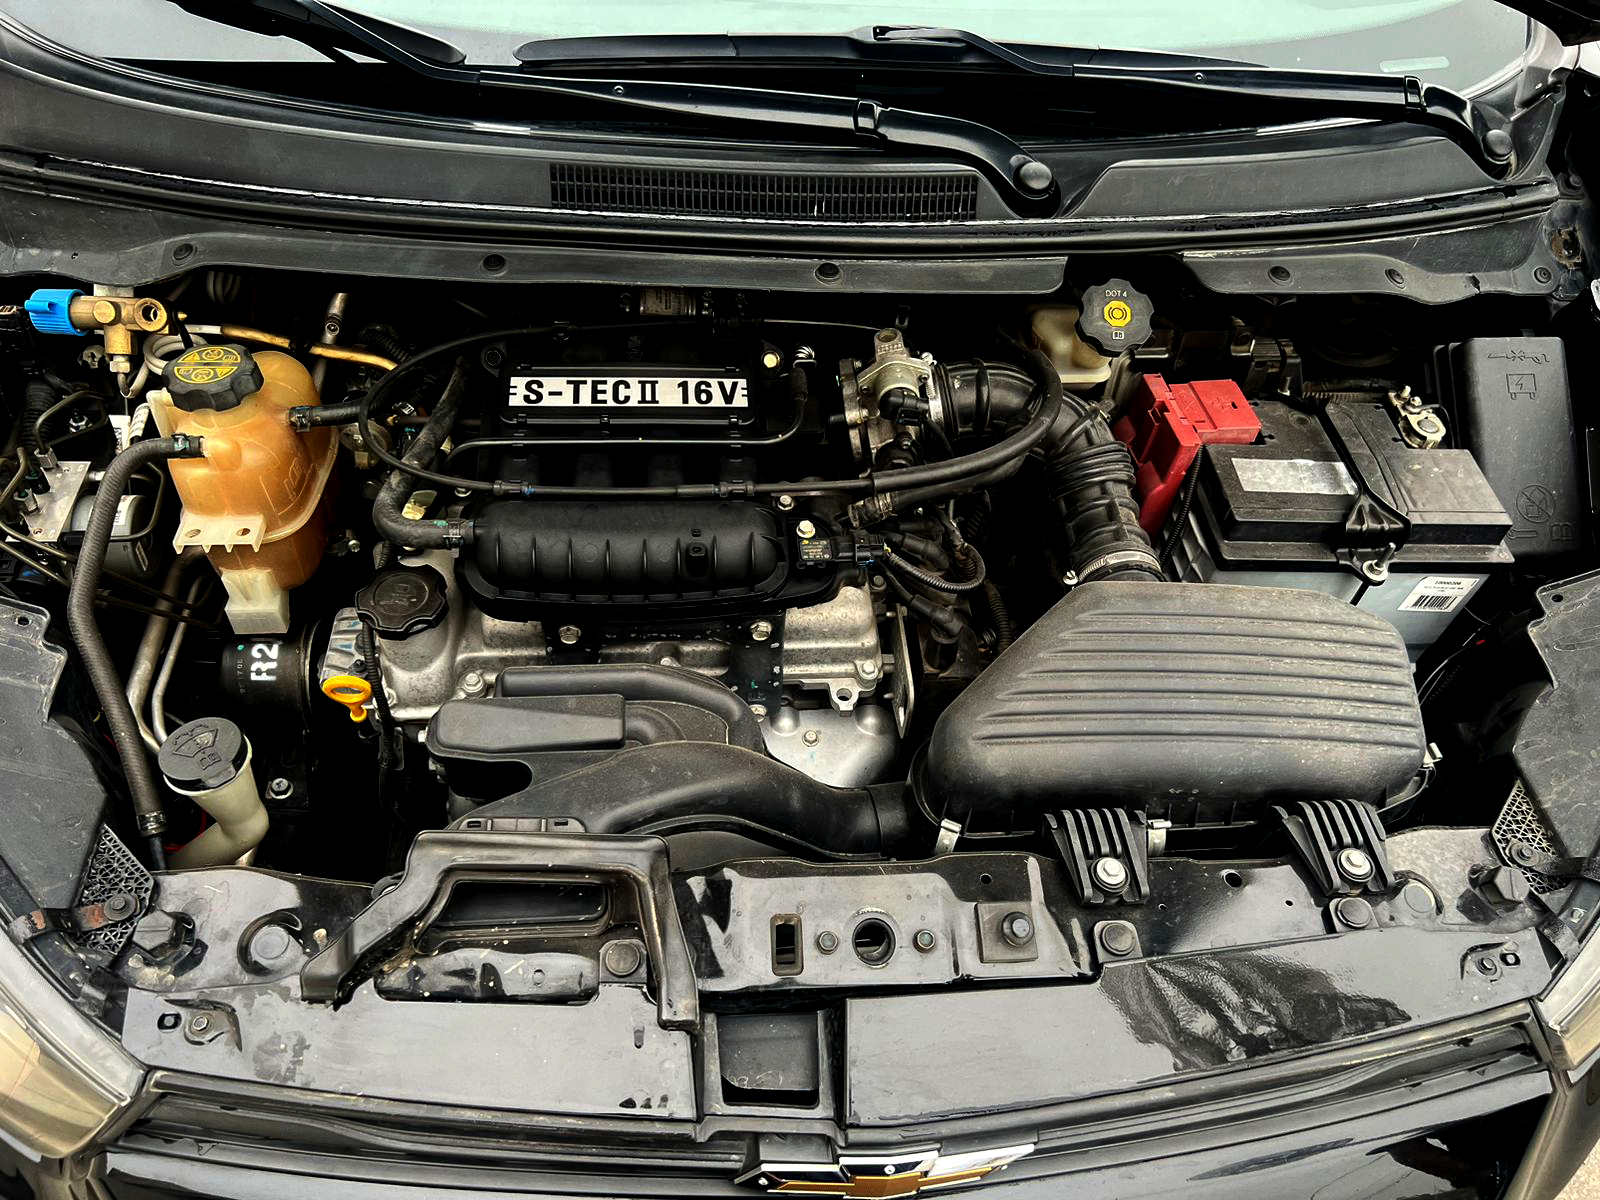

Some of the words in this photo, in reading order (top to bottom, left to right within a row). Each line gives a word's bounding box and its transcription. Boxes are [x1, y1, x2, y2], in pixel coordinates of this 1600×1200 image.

[1105, 289, 1121, 297] DOT
[677, 380, 739, 405] 16V
[250, 643, 279, 681] R2
